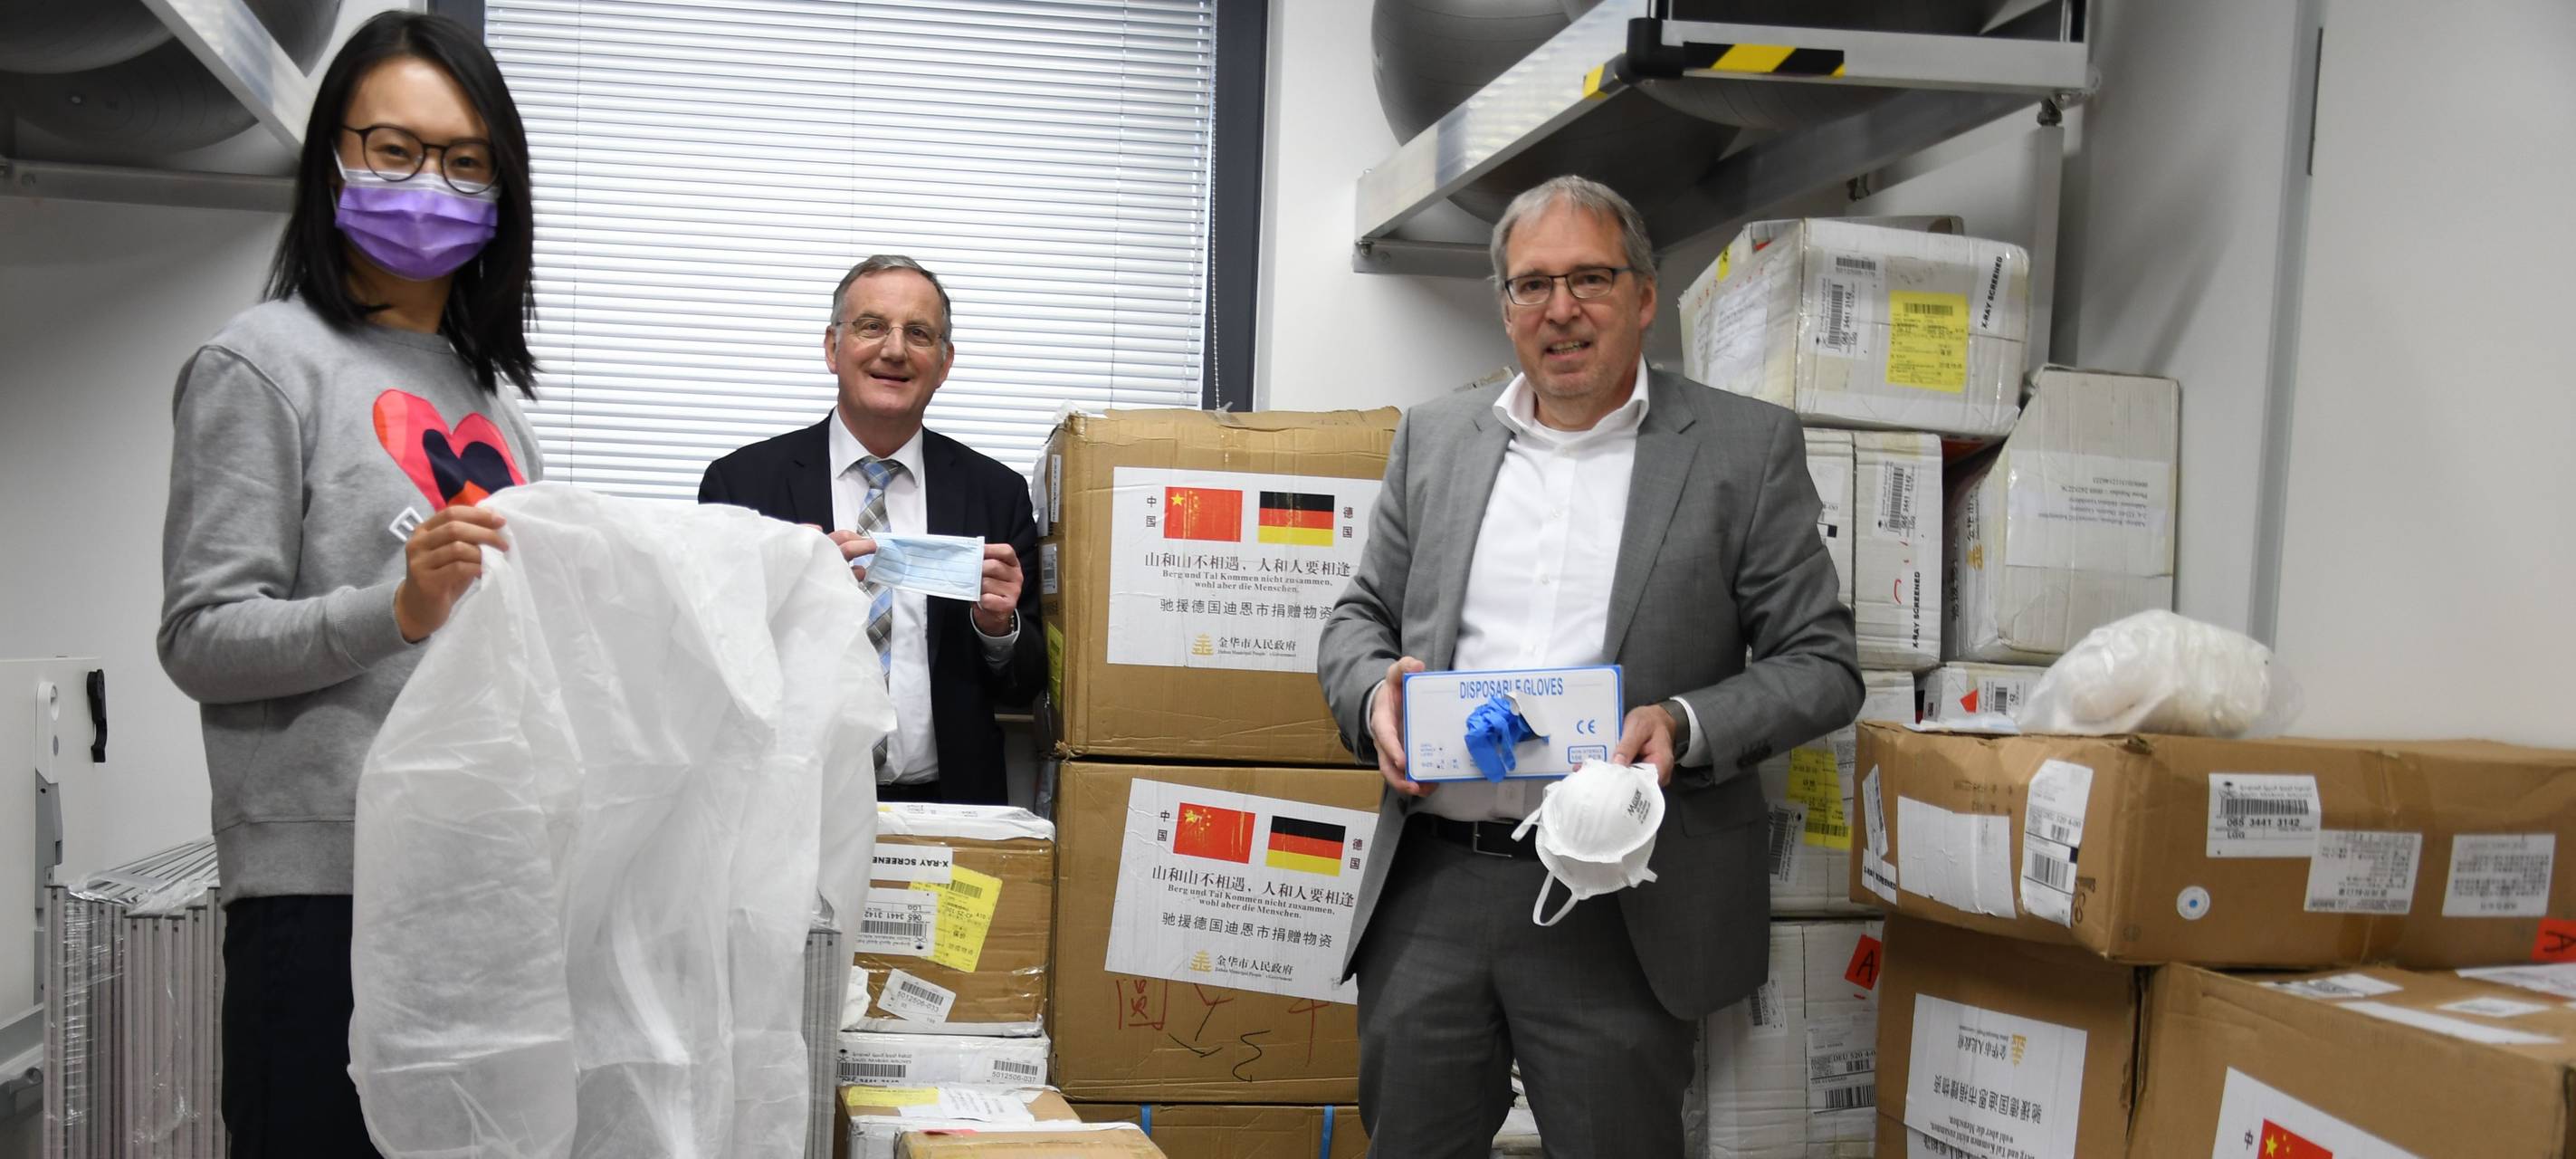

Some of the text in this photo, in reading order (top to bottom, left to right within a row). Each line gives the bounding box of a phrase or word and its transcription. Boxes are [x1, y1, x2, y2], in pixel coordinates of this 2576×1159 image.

[1163, 570, 1182, 580] Berg
[1185, 571, 1201, 580] und
[1203, 571, 1218, 580] Tal
[1220, 572, 1259, 582] Kommen
[1261, 574, 1283, 584] nicht
[1195, 580, 1216, 589] wohl
[1216, 581, 1236, 590] aber
[1238, 582, 1253, 591] die
[1159, 598, 1333, 620] 驰援德国迪恩市捐赠物资
[1912, 571, 1921, 649] X-RAY SCREENED
[1217, 636, 1297, 652] 金华市人民政府
[1459, 677, 1563, 699] DISPOSABLE GLOVES
[872, 856, 949, 867] X-RAY SCREENE
[1168, 884, 1188, 896] Berg
[1189, 886, 1207, 896] und
[1208, 889, 1223, 899] Tal
[1225, 892, 1264, 905] Kommen
[1264, 896, 1286, 907] nicht
[863, 910, 883, 919] 3142
[886, 912, 904, 920] 3441
[1198, 897, 1302, 919] wohl aber die Menschen.
[1161, 911, 1332, 949] 驰援德国迪恩市捐赠物资
[1216, 954, 1294, 975] 金华市人民政府
[1856, 949, 1875, 982] A
[1957, 1034, 2007, 1061] 金华市人民政府
[1933, 1074, 2042, 1125] 驰援德国迪恩市捐赠物资
[1955, 1129, 1970, 1143] nicht
[1970, 1135, 1995, 1152] Kommen
[1984, 1127, 1999, 1139] aber
[1999, 1131, 2014, 1144] wohl
[2245, 1129, 2255, 1151] 中
